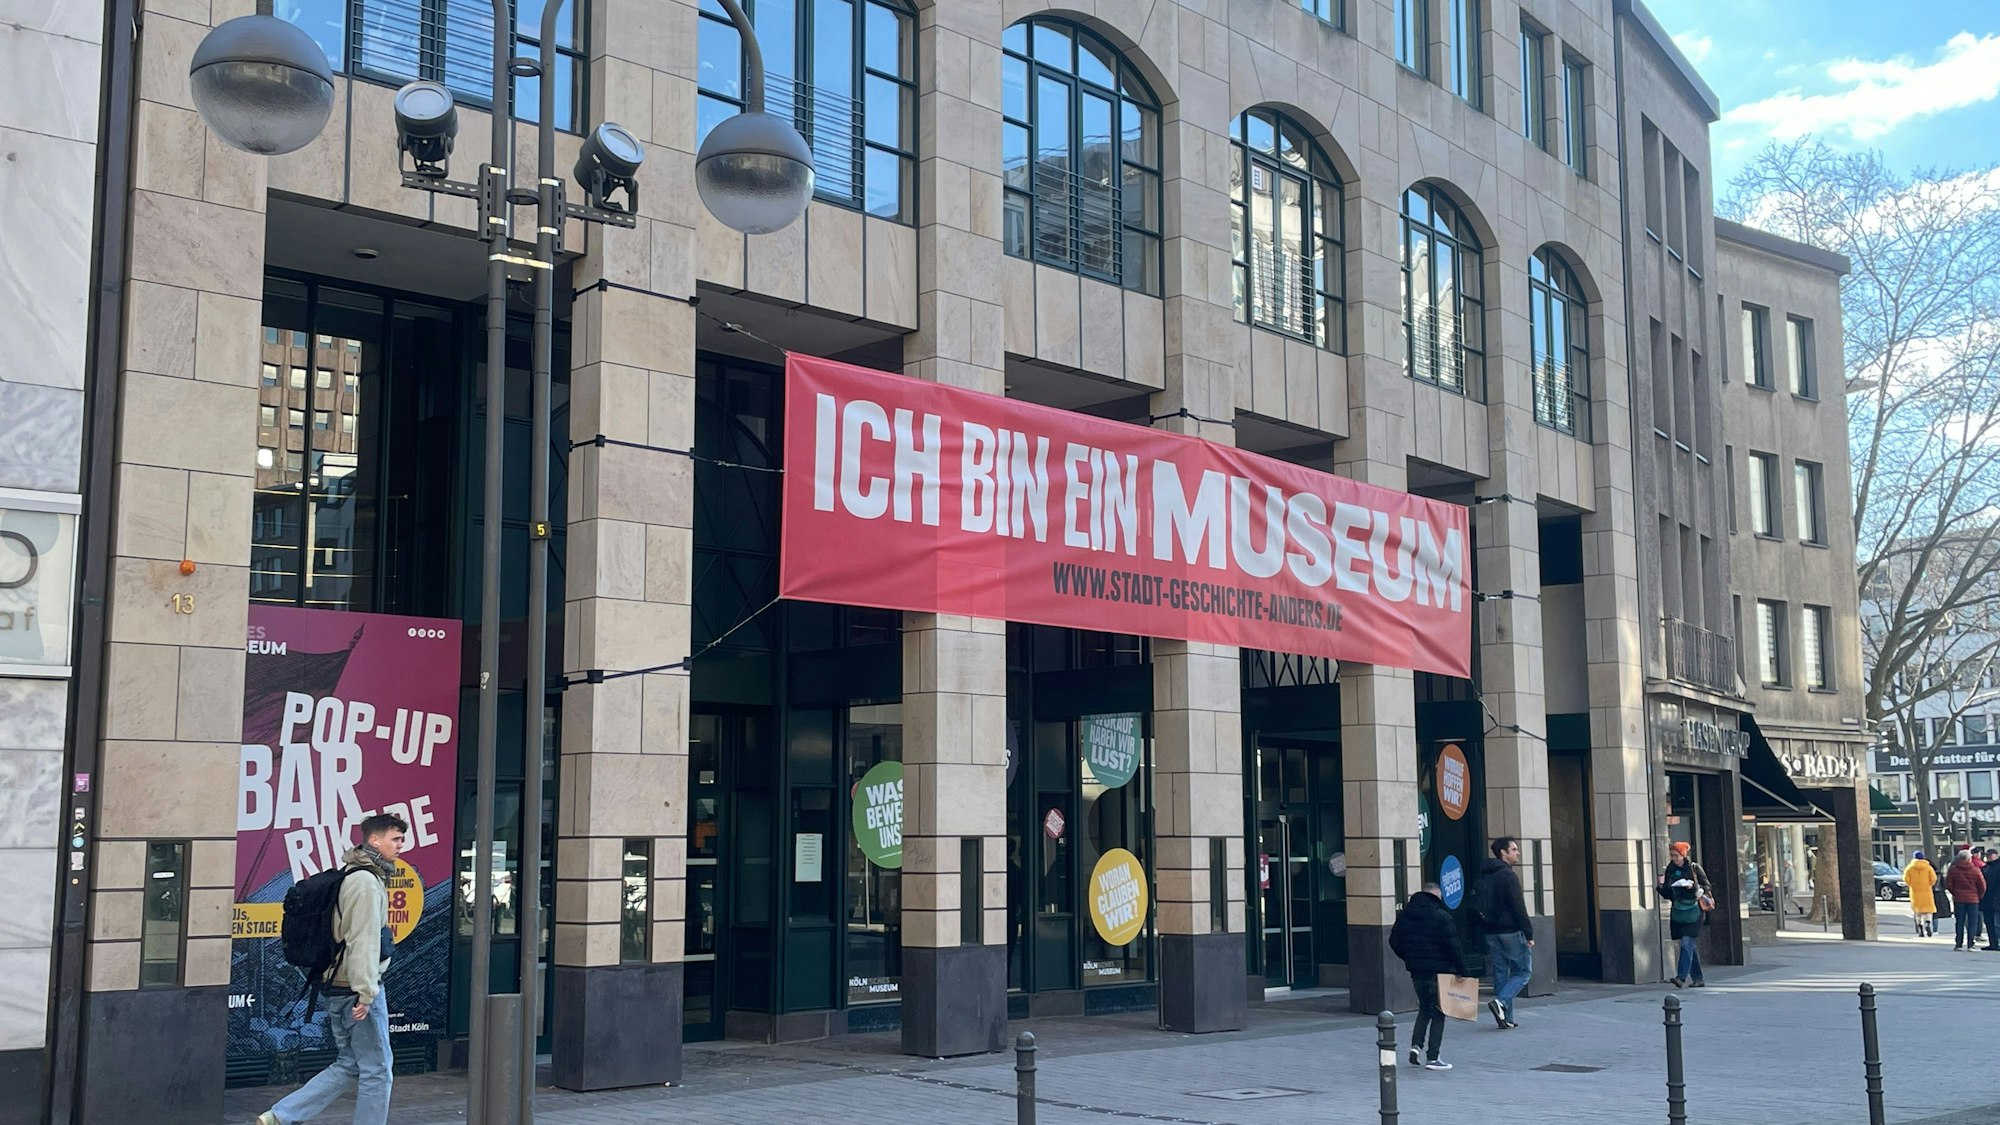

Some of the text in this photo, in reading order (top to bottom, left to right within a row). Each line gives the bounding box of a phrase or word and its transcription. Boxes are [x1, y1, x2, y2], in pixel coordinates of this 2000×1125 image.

[813, 392, 1464, 614] ICH BIN EIN MUSEUM
[537, 523, 546, 536] 5
[172, 593, 196, 615] 13
[1053, 561, 1343, 632] WWW.STADT-GESCHICHTE-ANDERS.DE
[279, 690, 453, 767] POP-UP
[1089, 724, 1136, 756] HABEN WIR
[1090, 744, 1133, 774] LUST?
[1974, 751, 1995, 763] für
[238, 743, 378, 832] BAR
[1443, 784, 1463, 808] WIR?
[865, 801, 904, 830] BEWE
[878, 823, 904, 849] UNS
[1098, 862, 1131, 893] WORAN
[1097, 878, 1141, 916] GLAUBEN
[246, 920, 278, 934] STAGE
[1104, 899, 1139, 931] WIR?
[389, 1022, 430, 1033] Stadt Köln
